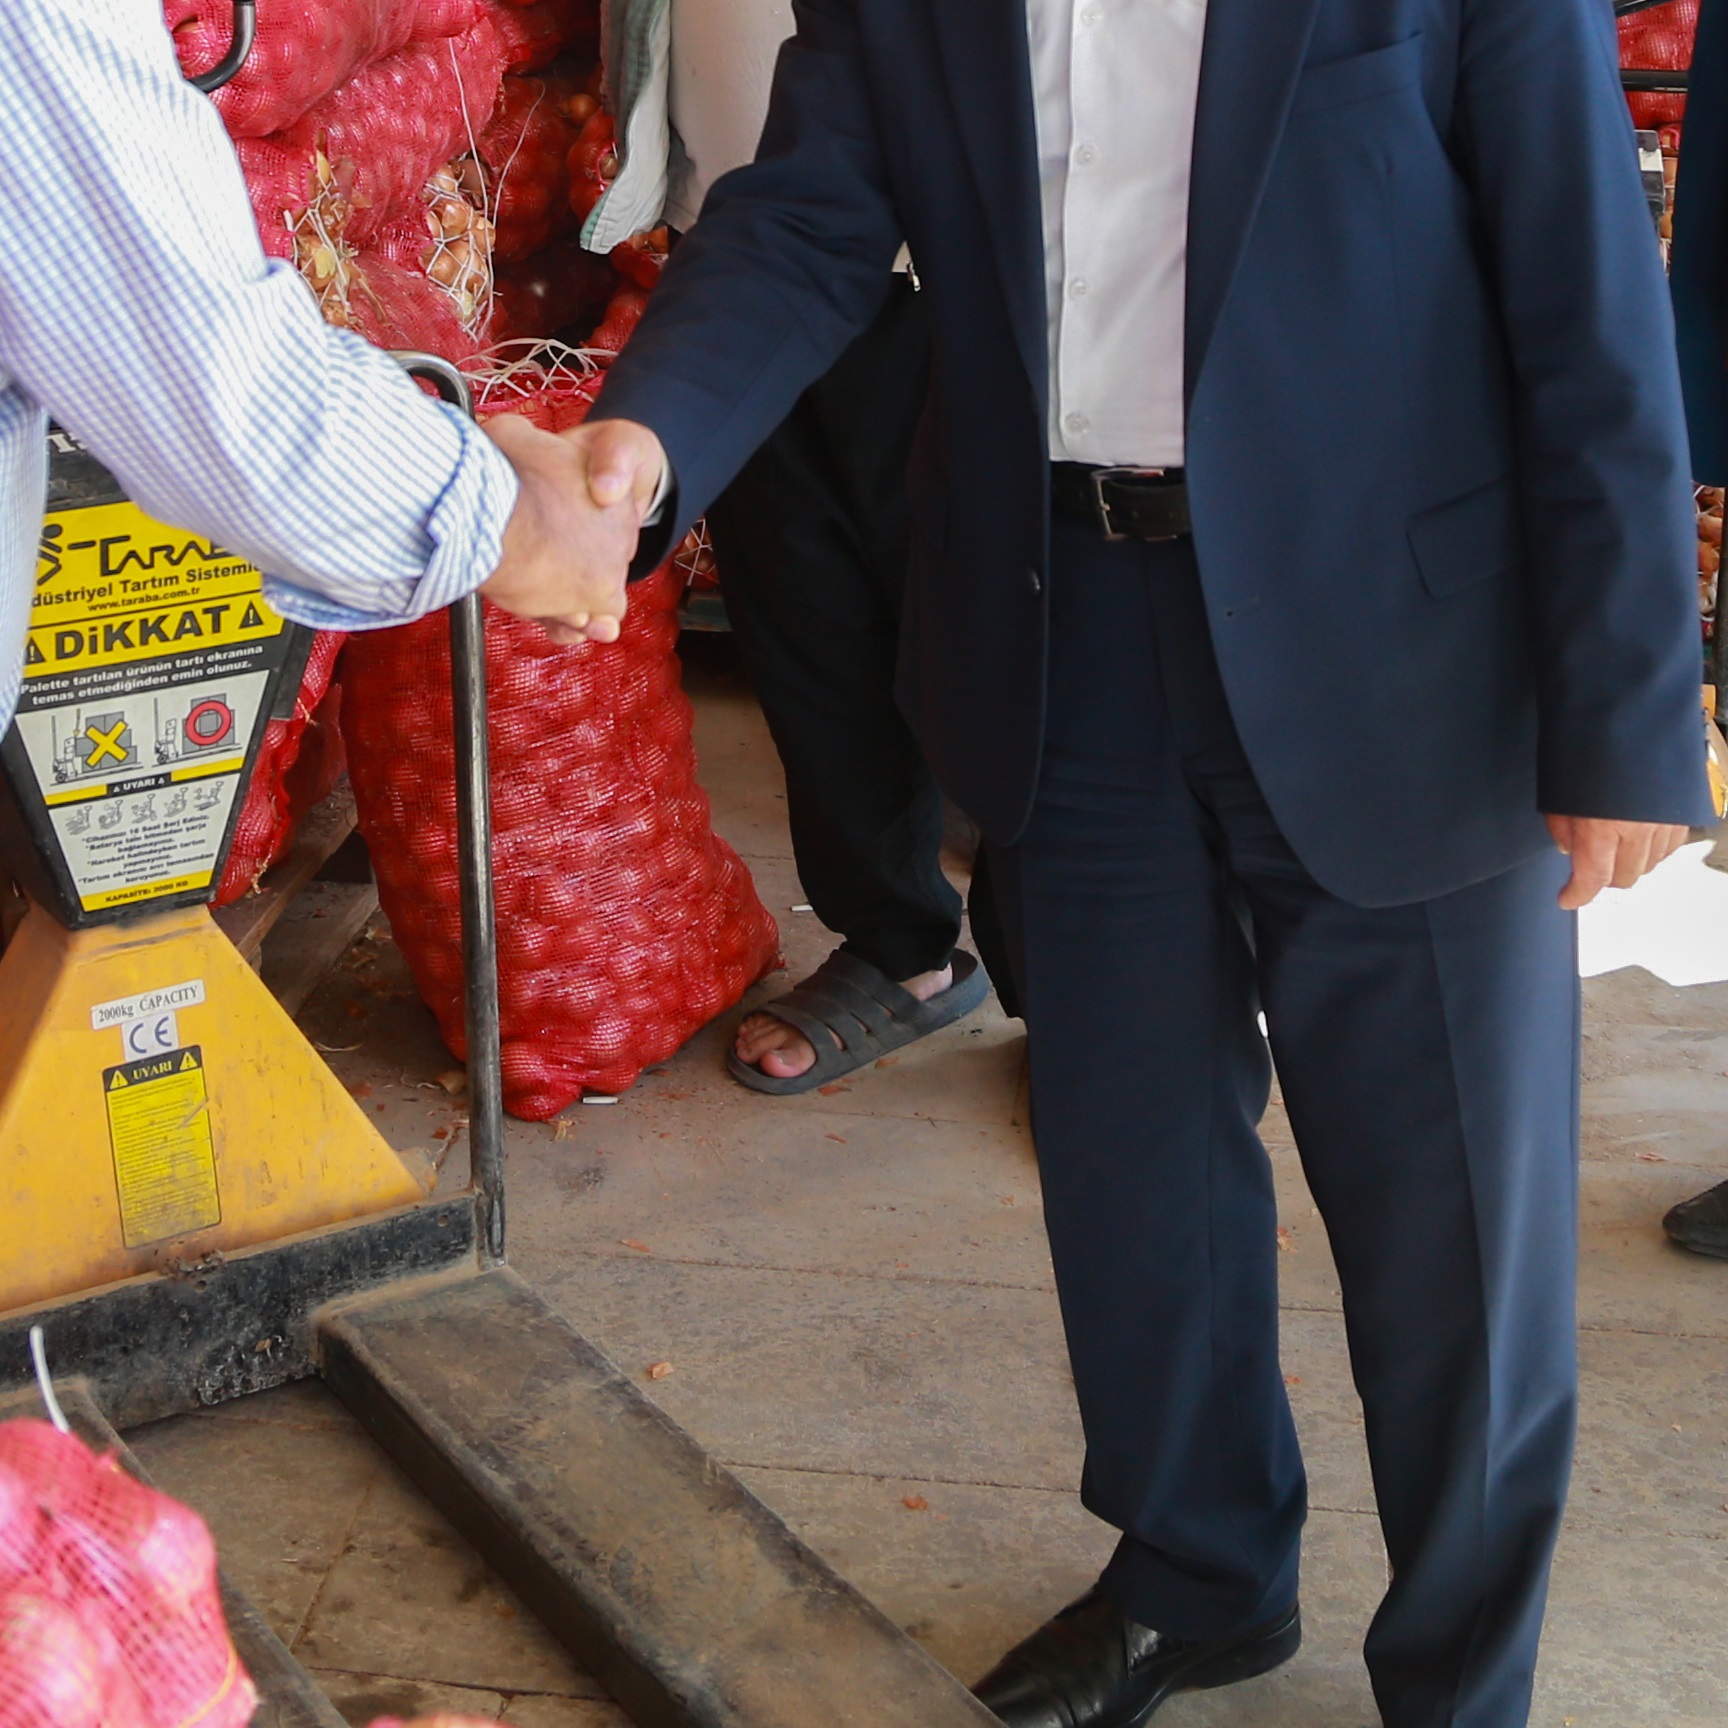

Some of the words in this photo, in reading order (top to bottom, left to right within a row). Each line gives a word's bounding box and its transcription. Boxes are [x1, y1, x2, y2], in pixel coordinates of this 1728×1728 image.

[32, 584, 113, 608] düstriyel
[119, 575, 179, 594] Tartım
[87, 585, 201, 612] www.taraba.com.tr
[21, 677, 70, 694] Palette
[73, 669, 123, 686] tartılan
[125, 661, 172, 677] ürünün
[175, 656, 204, 669] tartı
[206, 645, 263, 663] ekranına
[32, 690, 73, 705] temas
[78, 675, 169, 698] etmediğinden
[171, 669, 203, 682] emin
[206, 660, 252, 675] olunuz.
[123, 779, 156, 791] UYARI
[98, 1004, 134, 1022] 2000kg
[139, 985, 199, 1012] CAPACITY
[129, 1016, 172, 1054] CE
[132, 1060, 172, 1081] UYARI
